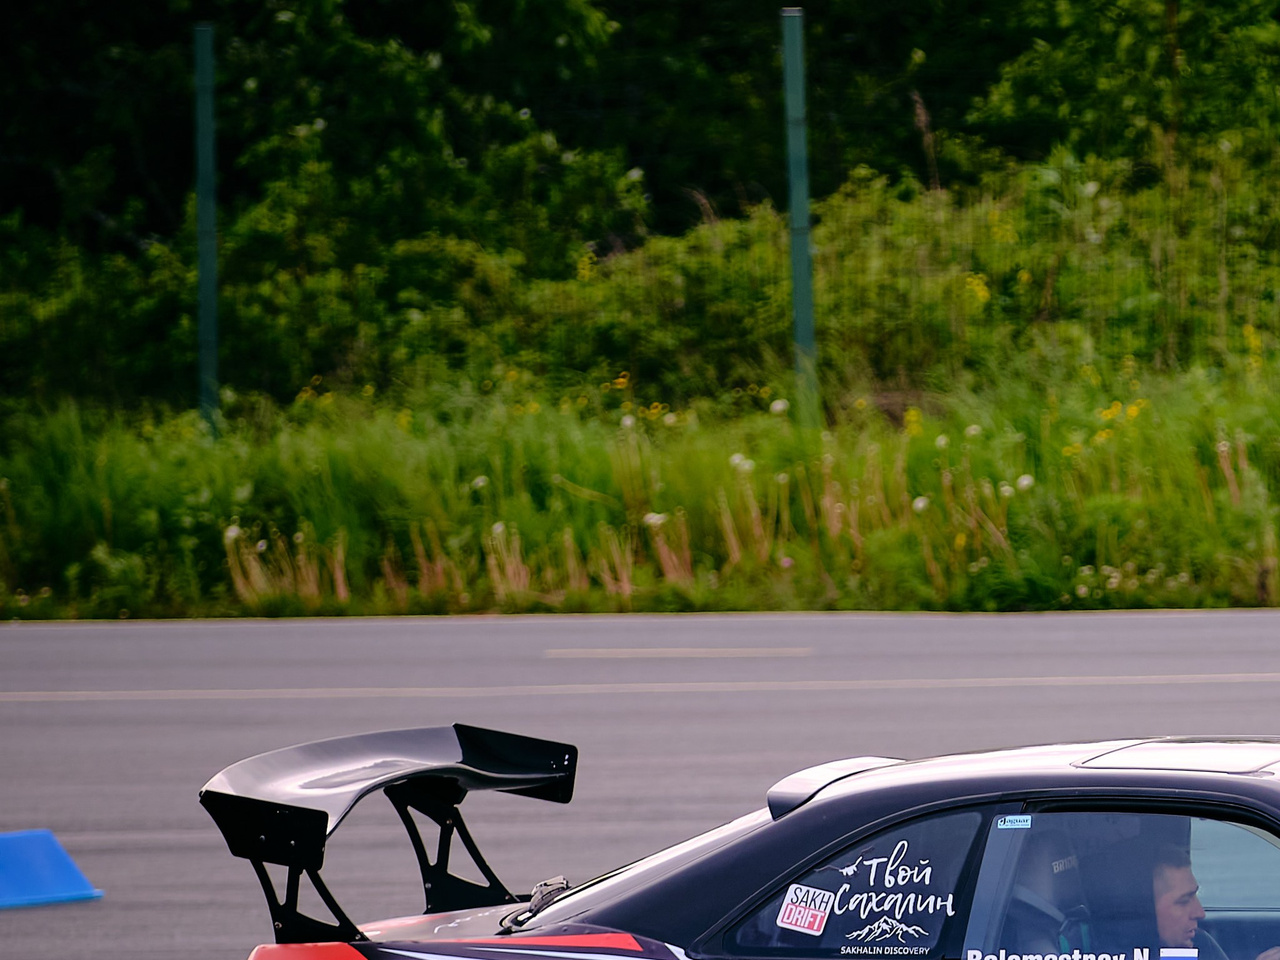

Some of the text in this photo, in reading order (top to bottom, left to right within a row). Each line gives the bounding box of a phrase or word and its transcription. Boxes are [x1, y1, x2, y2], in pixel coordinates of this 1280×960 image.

[863, 840, 932, 888] Твой
[790, 886, 833, 911] SAKH
[833, 883, 956, 920] Сахалин
[782, 904, 825, 931] DRIFT
[840, 946, 930, 955] SAKHALIN DISCOVERY
